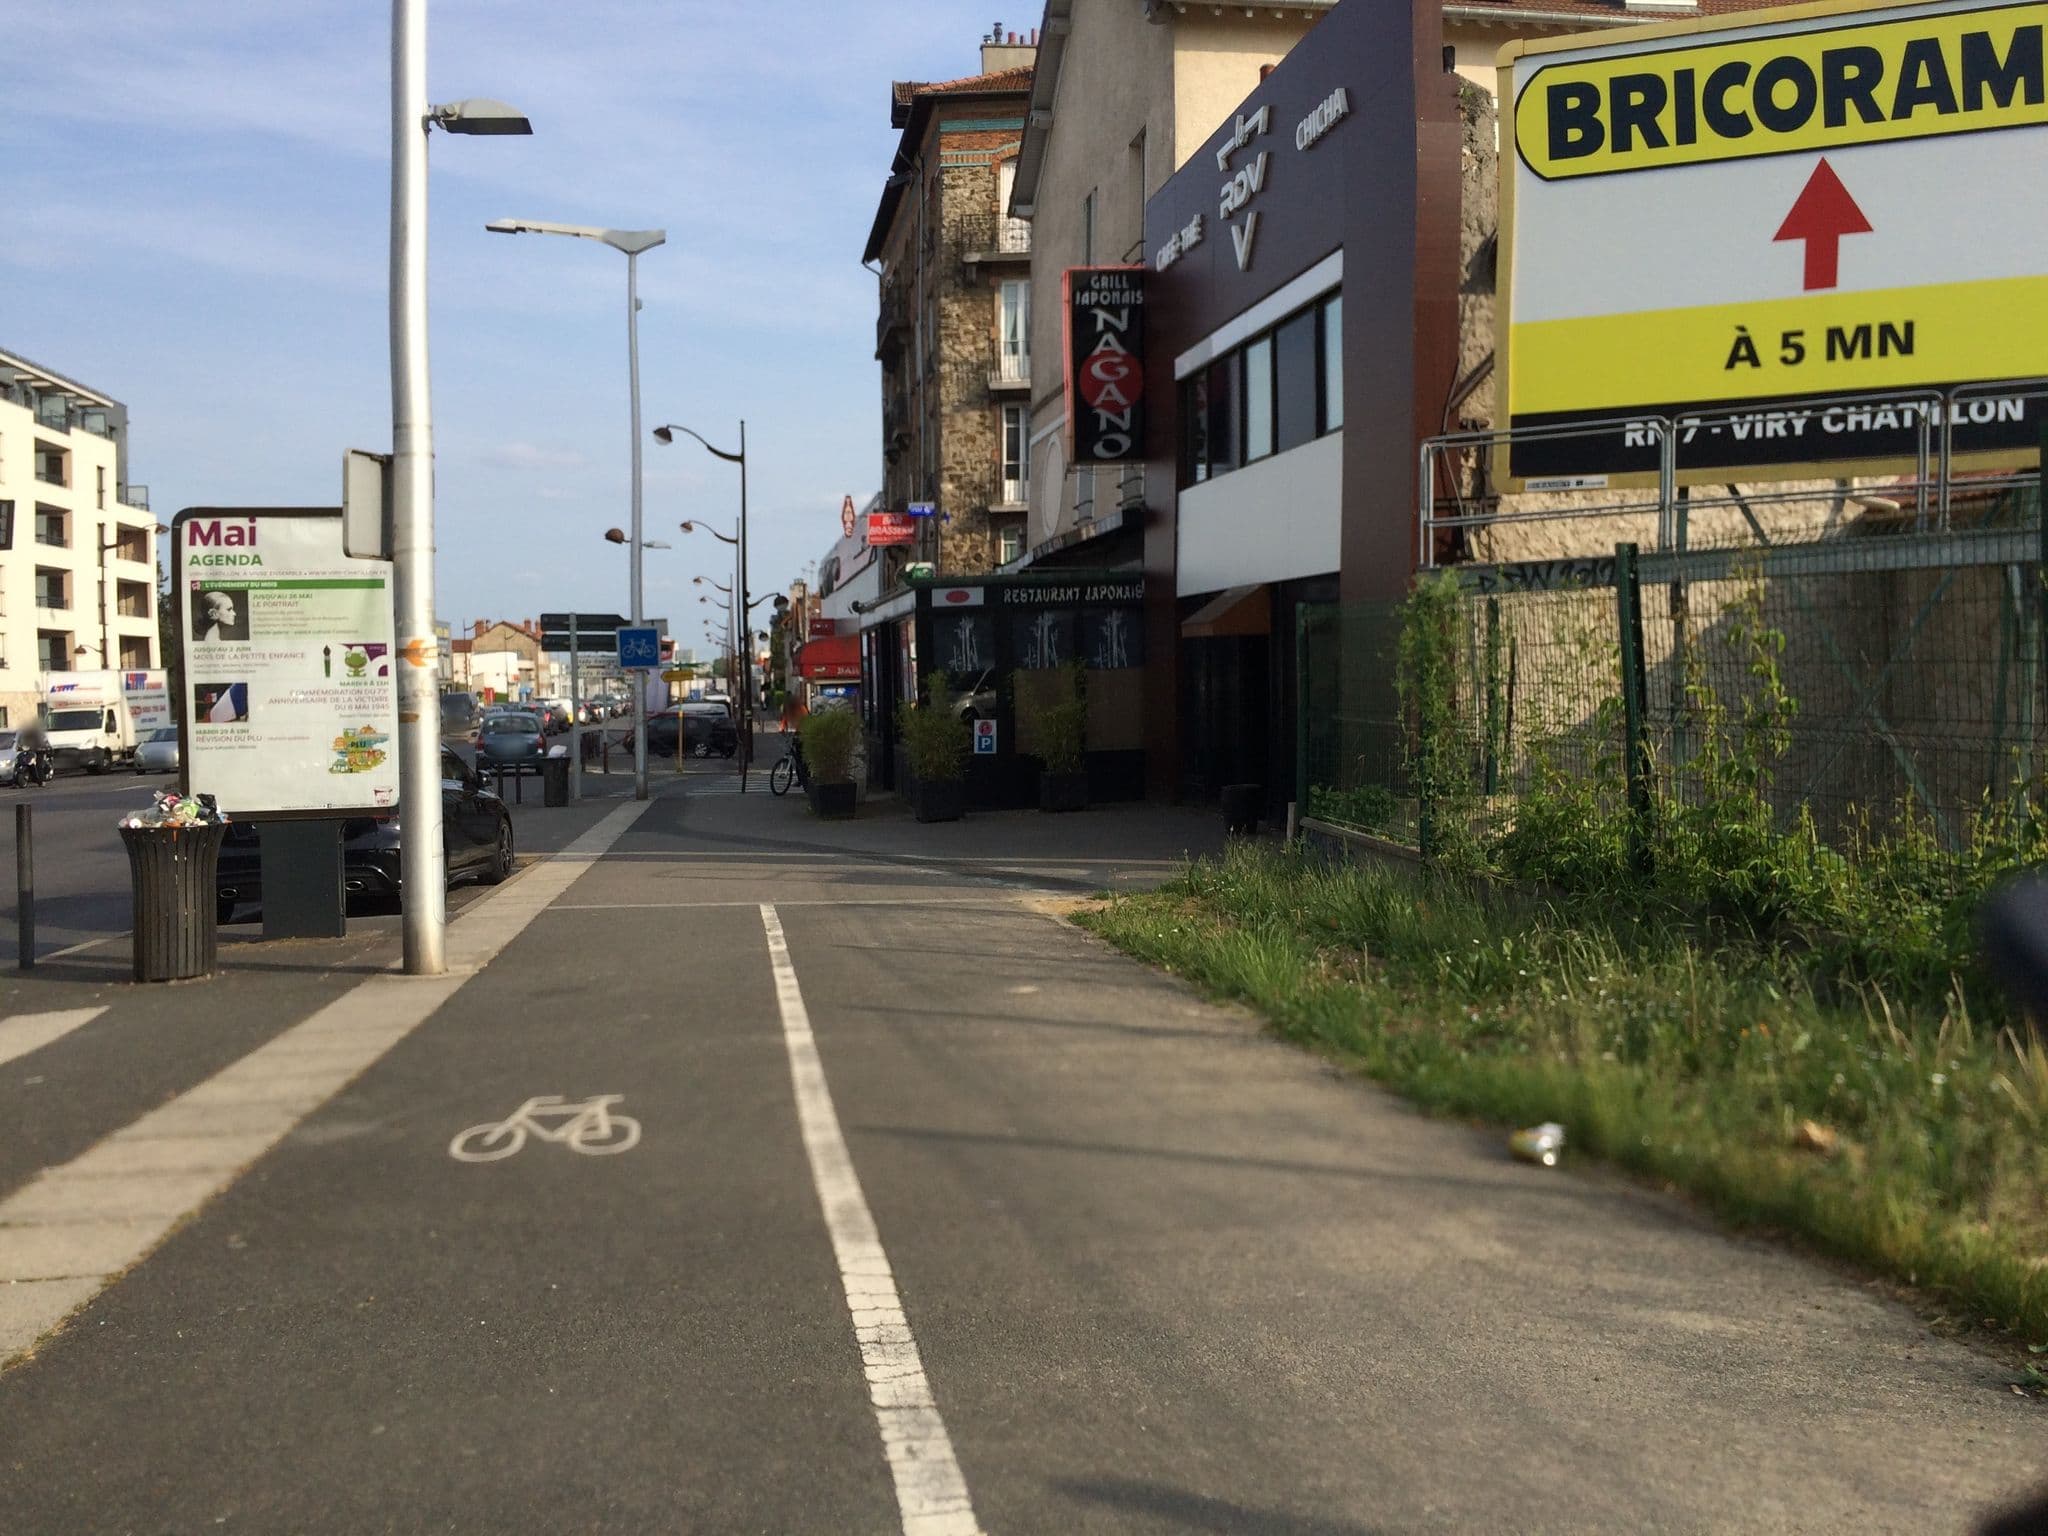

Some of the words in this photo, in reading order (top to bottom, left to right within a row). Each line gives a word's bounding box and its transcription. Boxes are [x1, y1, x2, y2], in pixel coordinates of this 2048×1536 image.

[1546, 25, 2045, 161] BRICORAM
[1296, 87, 1349, 151] CHICHA
[1075, 289, 1144, 305] JAPONAIS
[1090, 274, 1129, 289] GRILL
[1724, 326, 1762, 370] À
[1780, 330, 1805, 365] 5
[1826, 320, 1915, 362] MN
[1090, 308, 1132, 459] NAGANO
[1683, 418, 1701, 444] 7
[1730, 410, 1813, 441] VIRY
[188, 516, 256, 546] Mai
[188, 554, 263, 566] AGENDA
[1003, 587, 1080, 604] RESTAURANT
[1085, 579, 1145, 601] JAPONAIS
